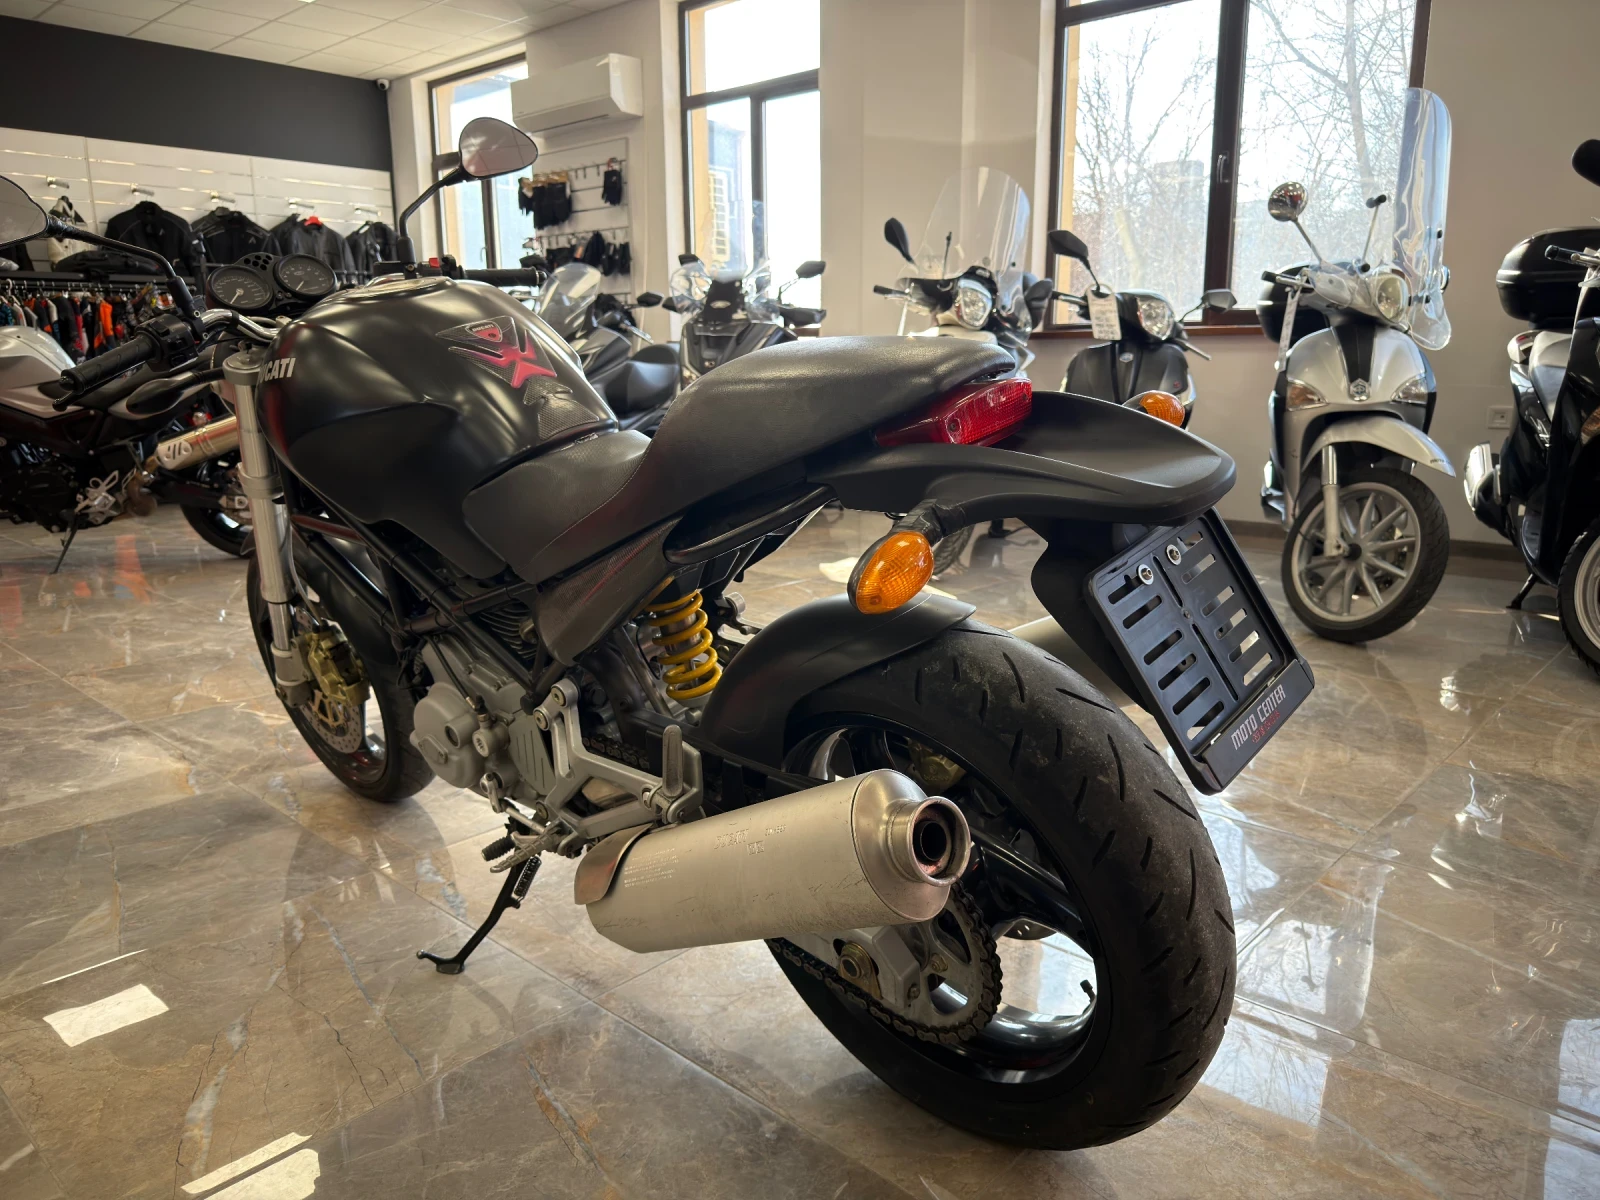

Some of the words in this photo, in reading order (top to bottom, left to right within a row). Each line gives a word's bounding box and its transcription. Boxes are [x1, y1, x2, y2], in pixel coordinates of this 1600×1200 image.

[260, 357, 296, 383] UCATI
[1230, 713, 1258, 750] MOTO
[1256, 684, 1286, 723] CENTER
